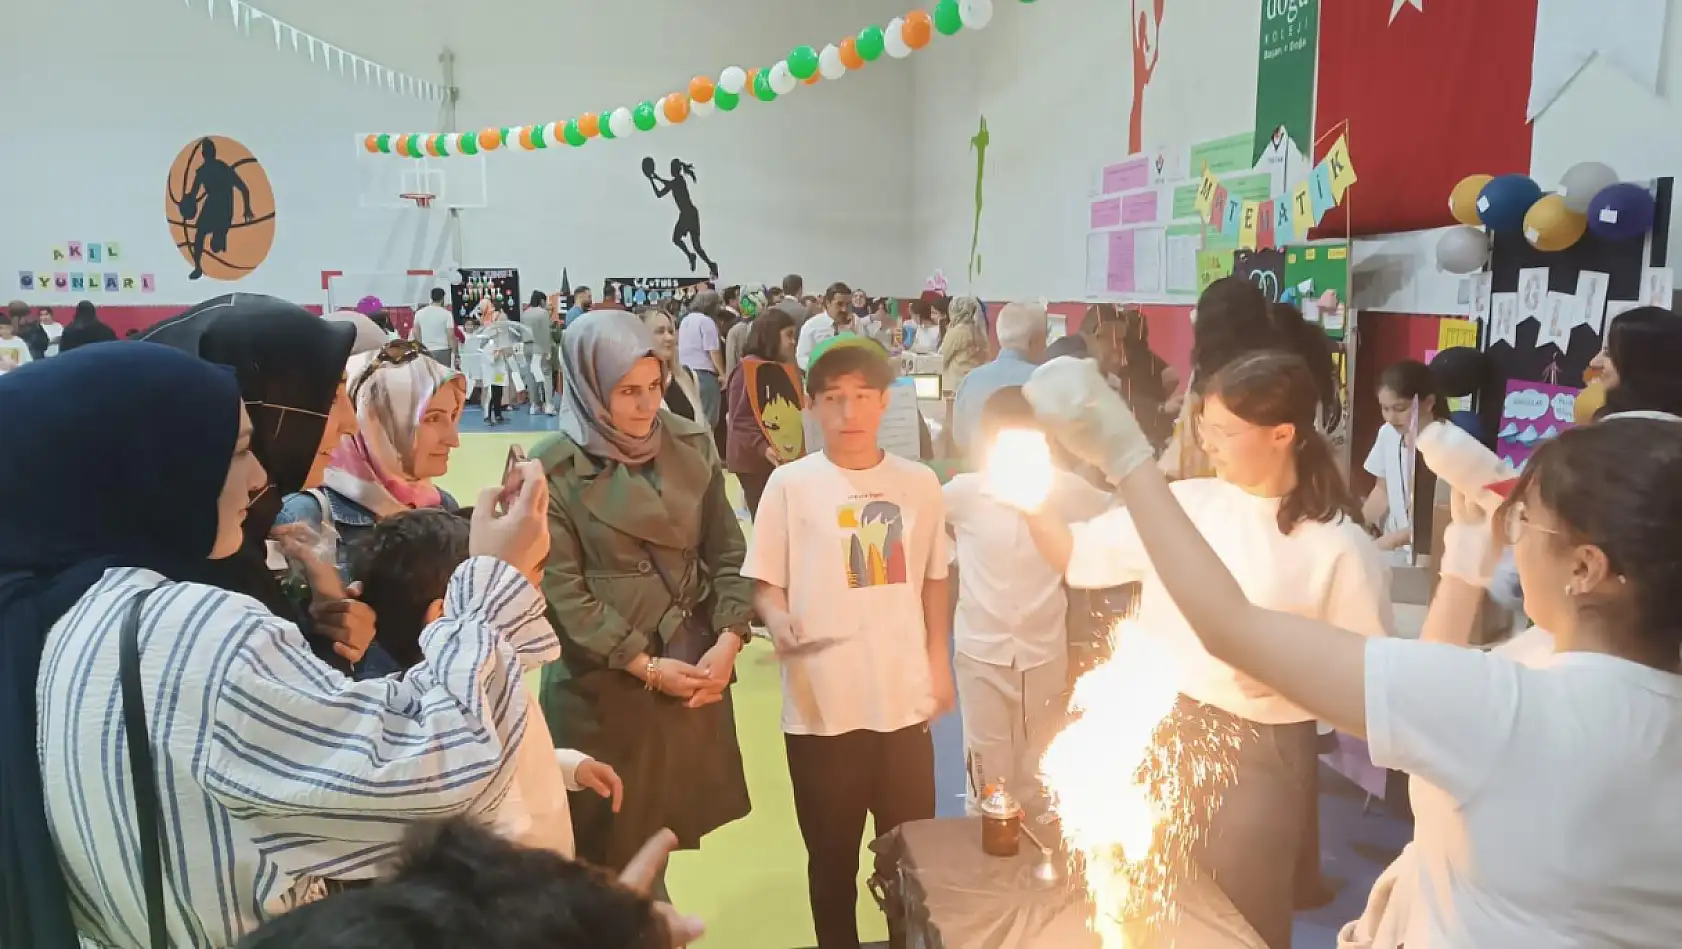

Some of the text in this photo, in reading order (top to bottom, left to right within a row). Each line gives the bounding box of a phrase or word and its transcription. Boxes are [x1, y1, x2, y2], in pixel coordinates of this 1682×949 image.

[1200, 149, 1345, 230] MATEMATİK
[53, 245, 118, 261] AKIL
[20, 275, 149, 289] OYUNLARI
